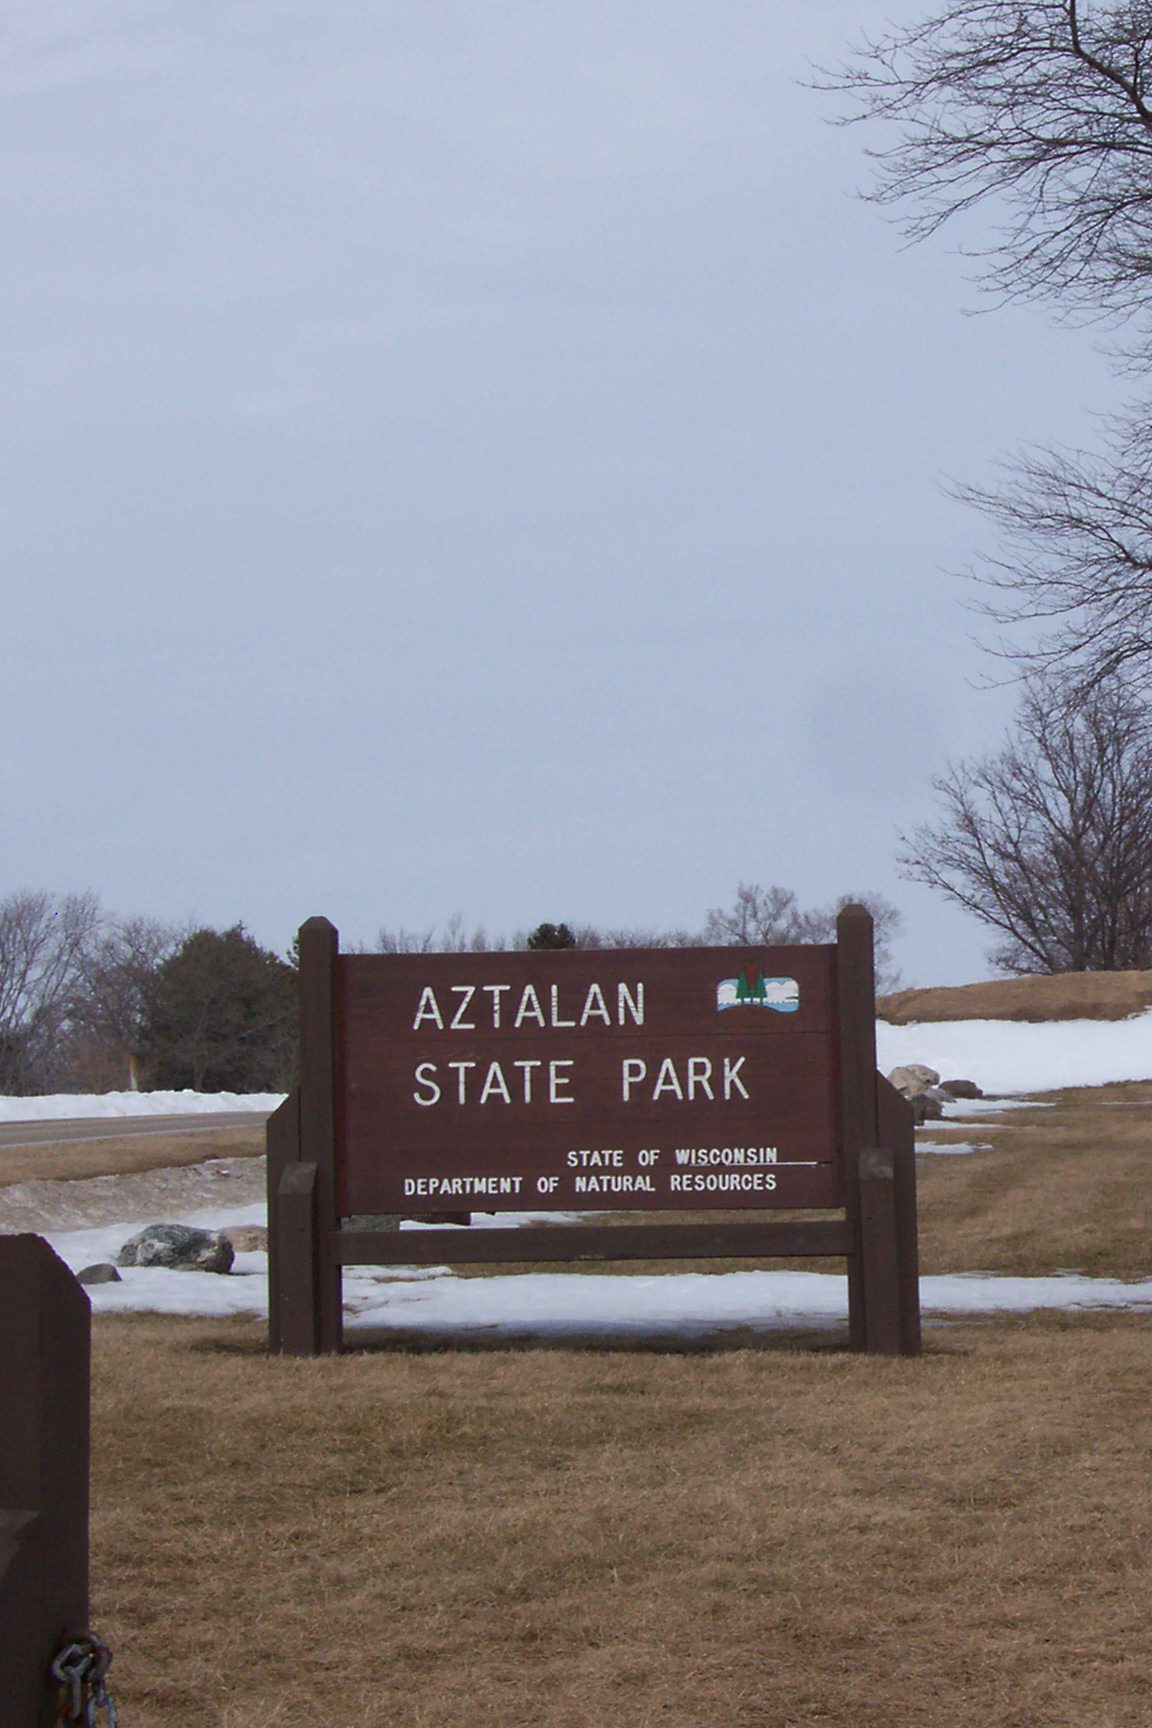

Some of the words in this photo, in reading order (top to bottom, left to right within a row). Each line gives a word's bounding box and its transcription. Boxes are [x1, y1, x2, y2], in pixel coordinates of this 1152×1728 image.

[412, 982, 644, 1031] AZTALAN
[413, 1060, 575, 1106] STATE
[622, 1056, 750, 1102] PARK
[566, 1149, 624, 1167] STATE
[637, 1149, 661, 1167] OF
[674, 1147, 779, 1167] WISCONSIN
[404, 1176, 523, 1196] DEPARTMENT
[536, 1176, 560, 1194] OF
[575, 1175, 656, 1193] NATURAL
[670, 1173, 777, 1192] RESOURCES
